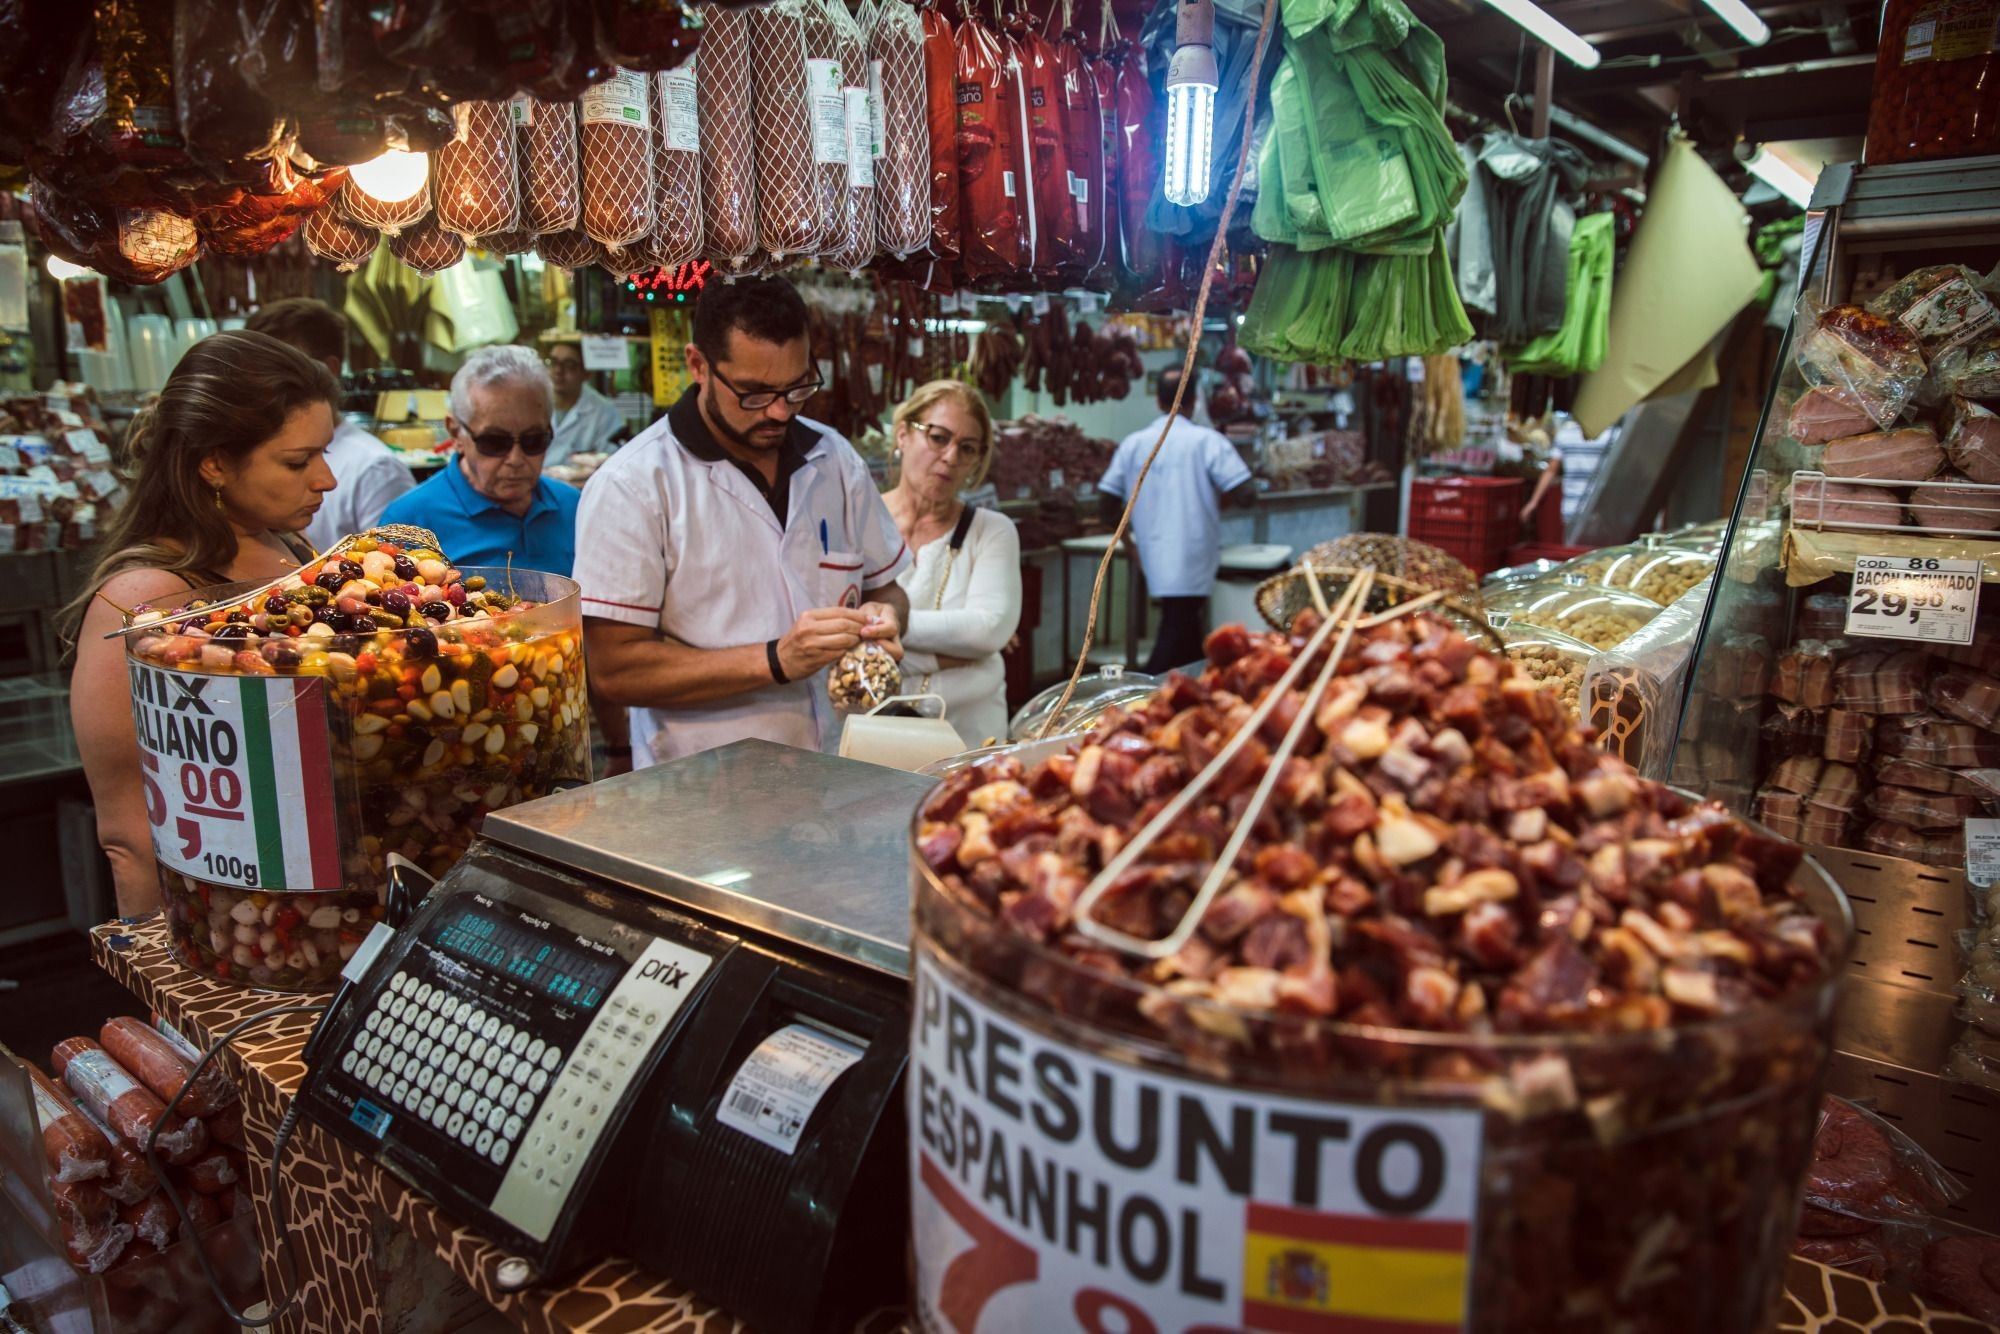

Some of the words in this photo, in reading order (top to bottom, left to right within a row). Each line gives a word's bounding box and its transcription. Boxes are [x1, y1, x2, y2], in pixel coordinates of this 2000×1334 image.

[1857, 559, 1893, 569] COD:
[1909, 557, 1940, 570] 86
[1856, 571, 1900, 586] BACON
[1904, 573, 1976, 592] DEFUMADO
[1951, 604, 1966, 613] Kg
[129, 660, 215, 716] MIX
[203, 852, 259, 887] 100g
[635, 958, 690, 990] prix
[920, 968, 1447, 1218] PRESUNTO
[920, 1065, 1227, 1305] ESPANHOL
